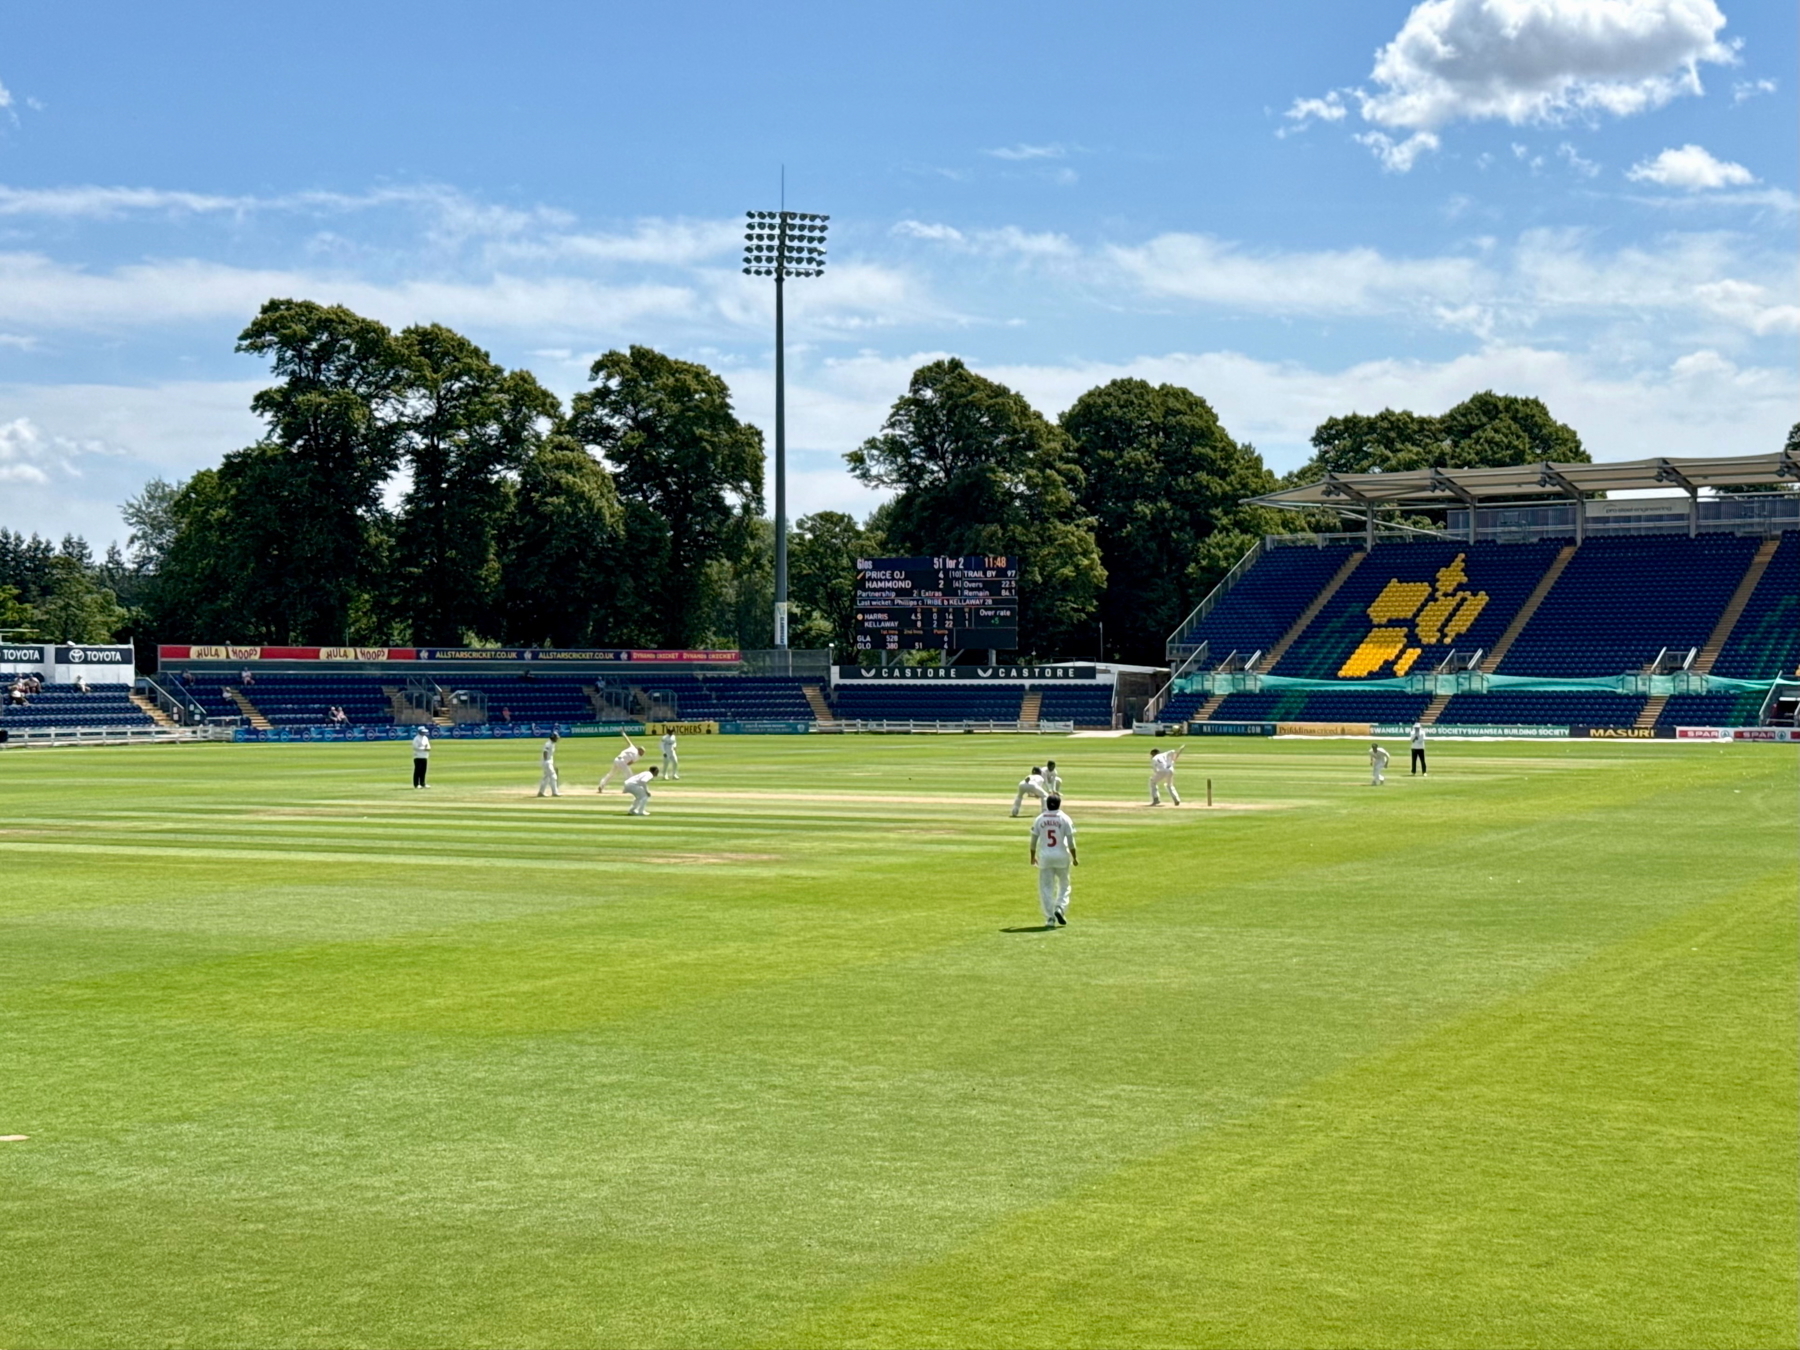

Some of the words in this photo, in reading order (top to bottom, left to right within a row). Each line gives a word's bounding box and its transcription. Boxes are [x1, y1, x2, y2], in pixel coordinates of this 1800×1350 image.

[857, 558, 872, 569] Glos
[934, 557, 942, 569] 51
[946, 557, 956, 568] for
[959, 558, 964, 568] 2
[985, 556, 1006, 568] 11:48
[866, 570, 891, 579] PRICE
[894, 570, 905, 579] OJ
[866, 580, 912, 588] HAMMOND
[857, 590, 896, 598] Partnership
[2, 650, 40, 660] TOYOTA
[86, 651, 122, 661] TOYOTA
[197, 646, 220, 658] HULA
[232, 648, 258, 659] HOOPS
[326, 648, 349, 659] HULA
[360, 648, 385, 660] HOOPS
[435, 651, 518, 659] ALLSTARSCRICKET.CO.UK
[538, 651, 614, 659] ALLSTARSCRICKET.CO.UK
[882, 668, 956, 678] CASTORE
[998, 668, 1075, 677] CASTORE
[1590, 728, 1654, 737] MASURI
[1047, 829, 1057, 847] 5
